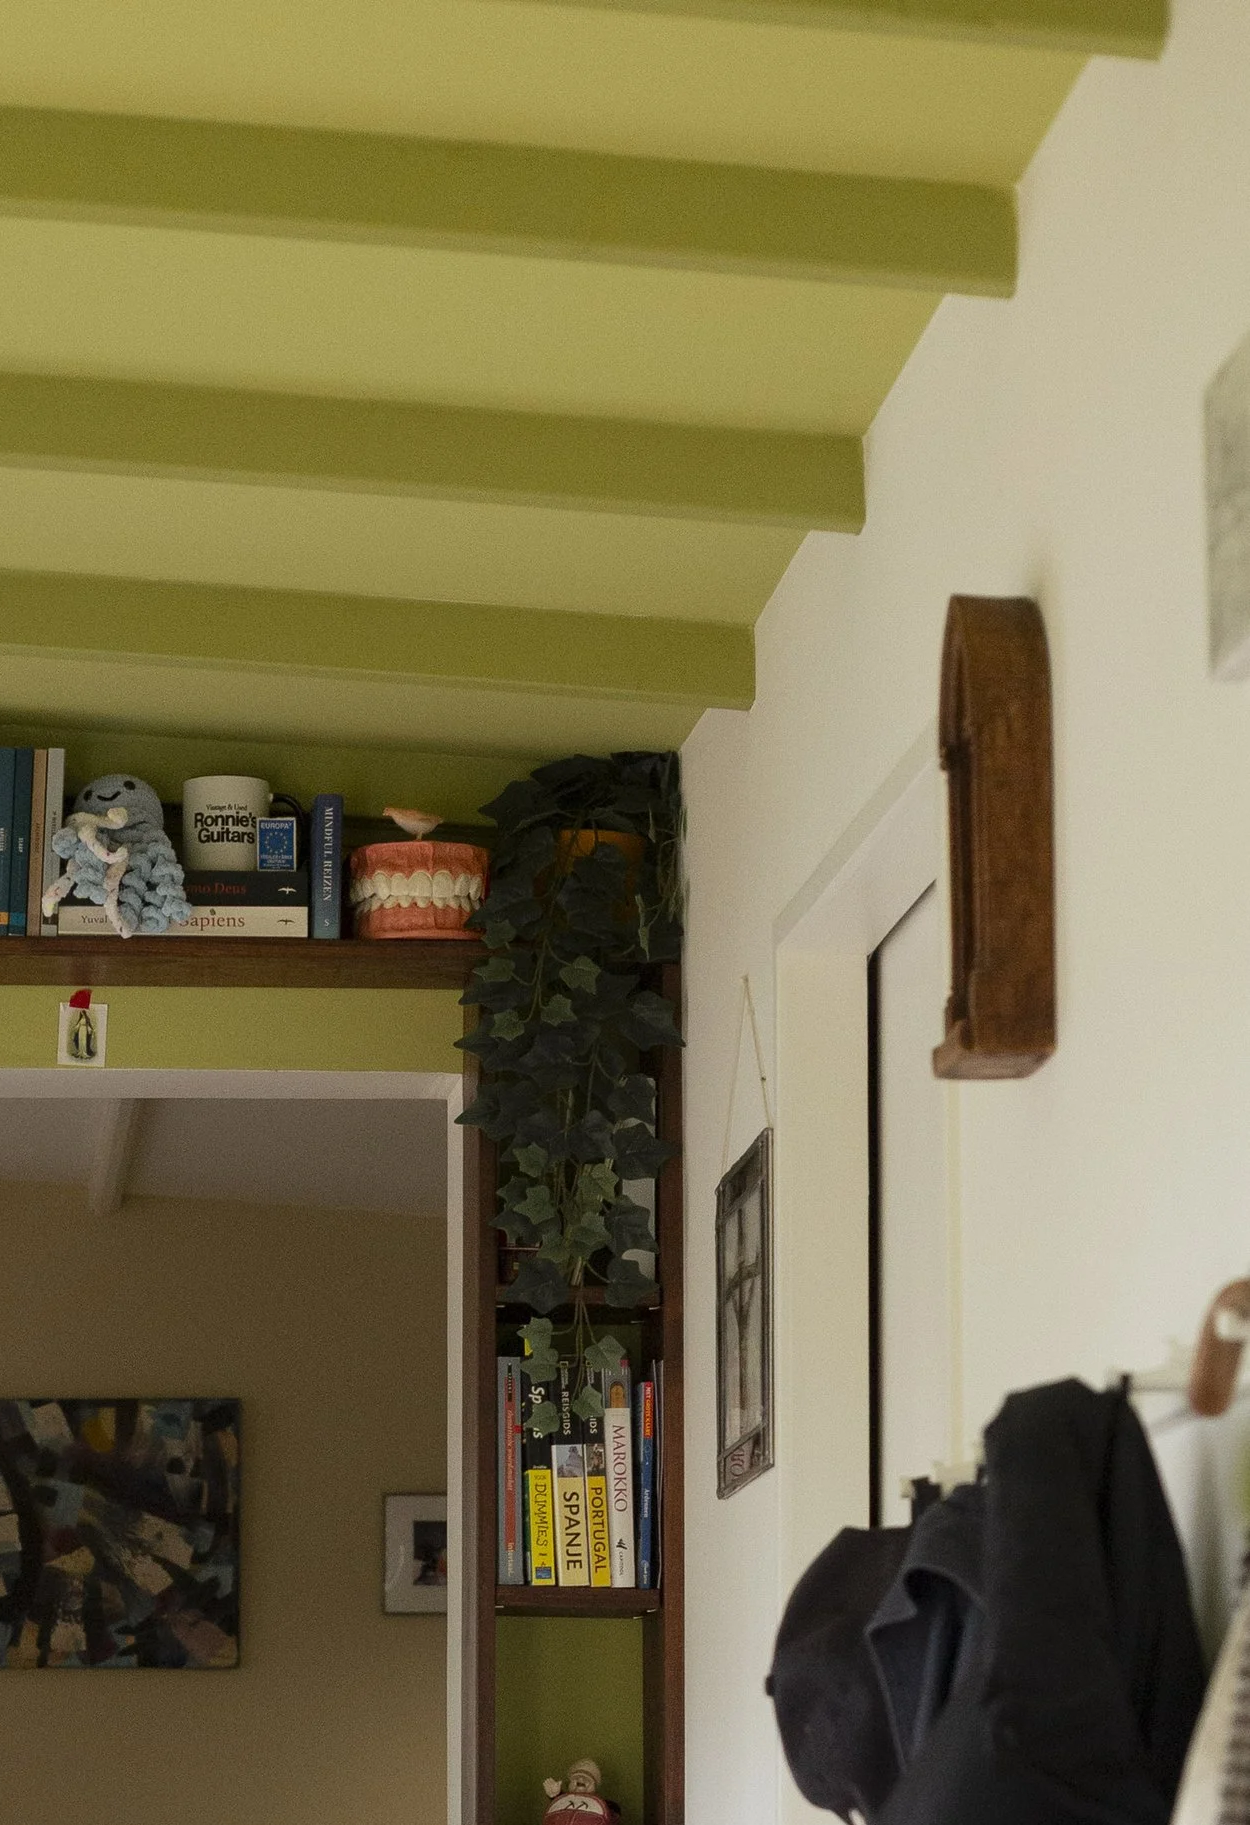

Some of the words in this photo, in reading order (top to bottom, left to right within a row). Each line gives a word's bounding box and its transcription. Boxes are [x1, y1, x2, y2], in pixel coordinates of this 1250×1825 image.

[194, 812, 257, 829] Ronnie's
[206, 804, 227, 812] Vintage
[234, 804, 248, 812] Used
[322, 806, 334, 858] MINDFUL
[198, 828, 255, 845] Guitars
[321, 860, 333, 902] REIZEN
[561, 1391, 572, 1436] REISGIDS
[612, 1424, 628, 1513] MAROKKO
[535, 1482, 548, 1547] DUMMIES
[562, 1491, 583, 1571] SPANJE
[591, 1487, 606, 1574] PORTUGAL
